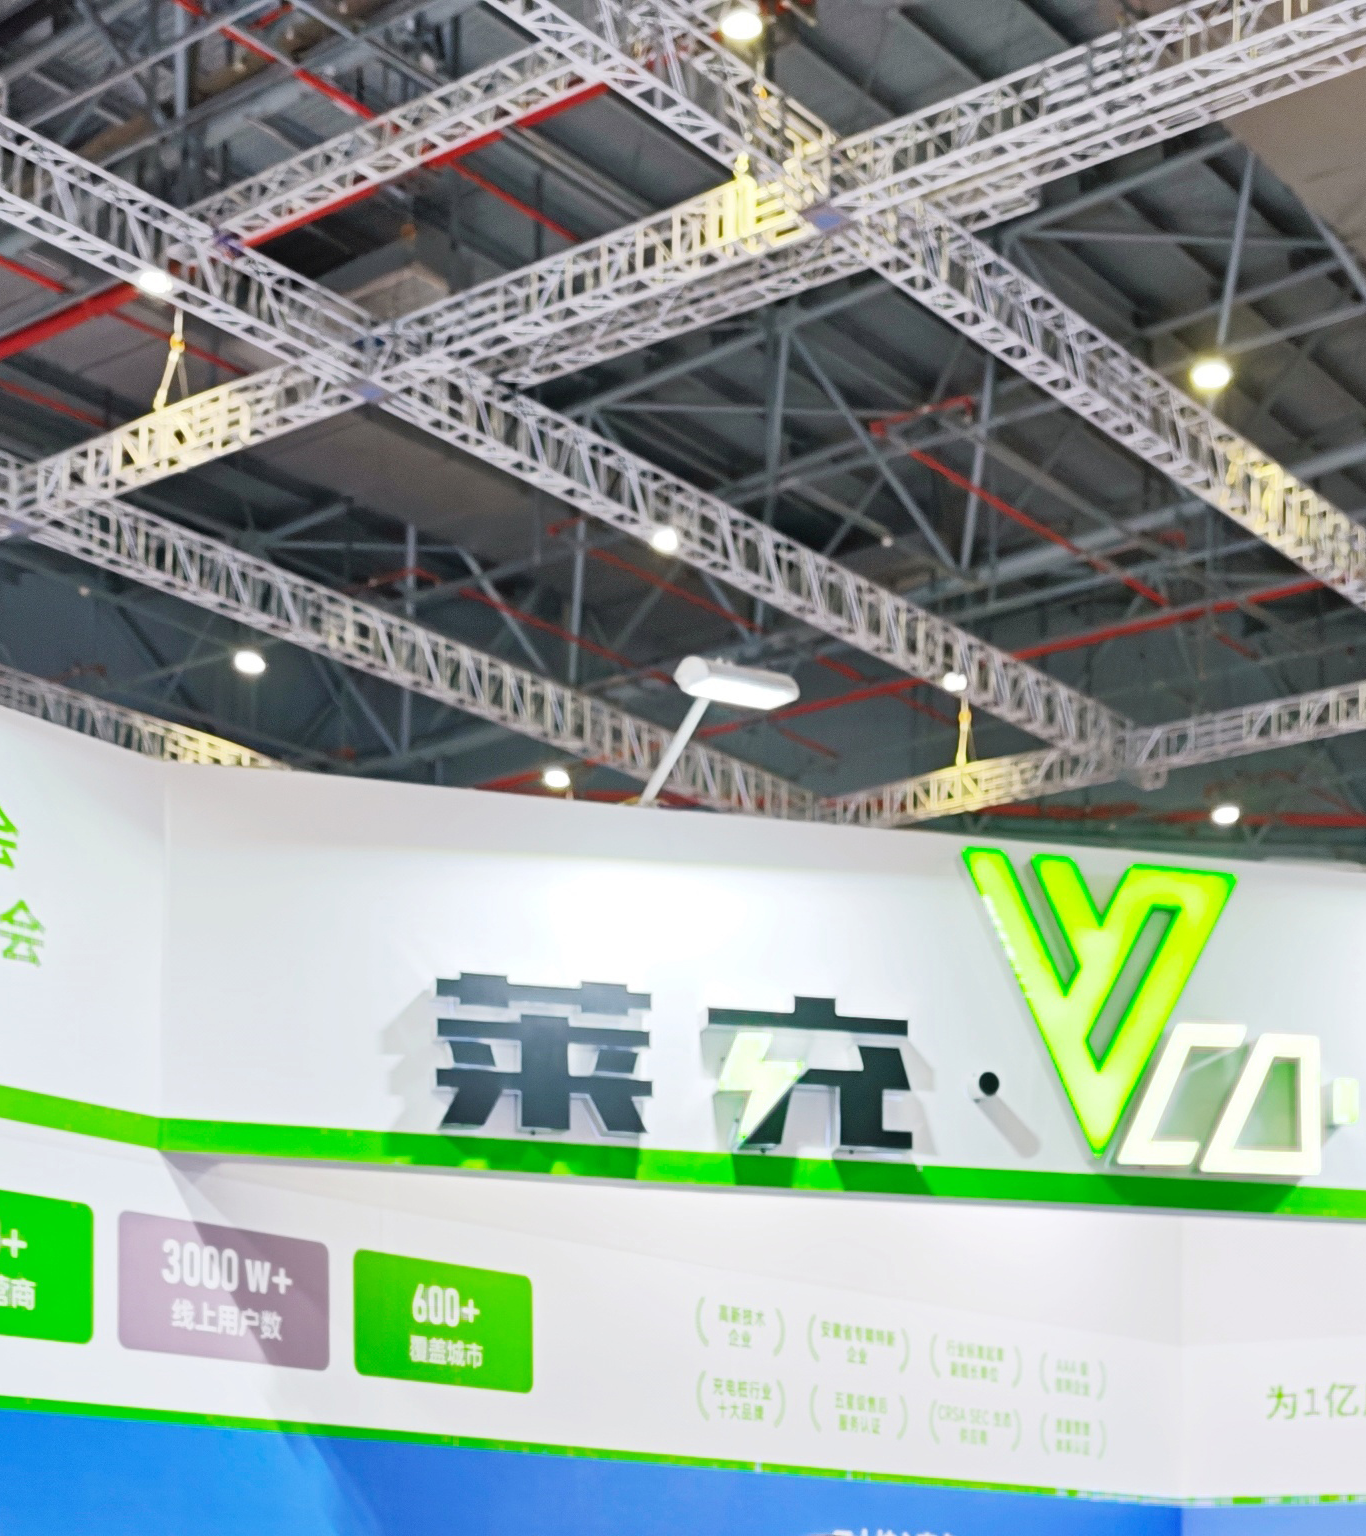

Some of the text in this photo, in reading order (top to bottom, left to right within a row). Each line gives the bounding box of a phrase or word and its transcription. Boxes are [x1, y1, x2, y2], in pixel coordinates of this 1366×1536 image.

[435, 971, 913, 1151] 莱充
[161, 1236, 294, 1295] 3000 W+
[171, 1296, 284, 1342] 线上用户数
[411, 1282, 482, 1328] 600+
[409, 1333, 485, 1371] 覆盖城市
